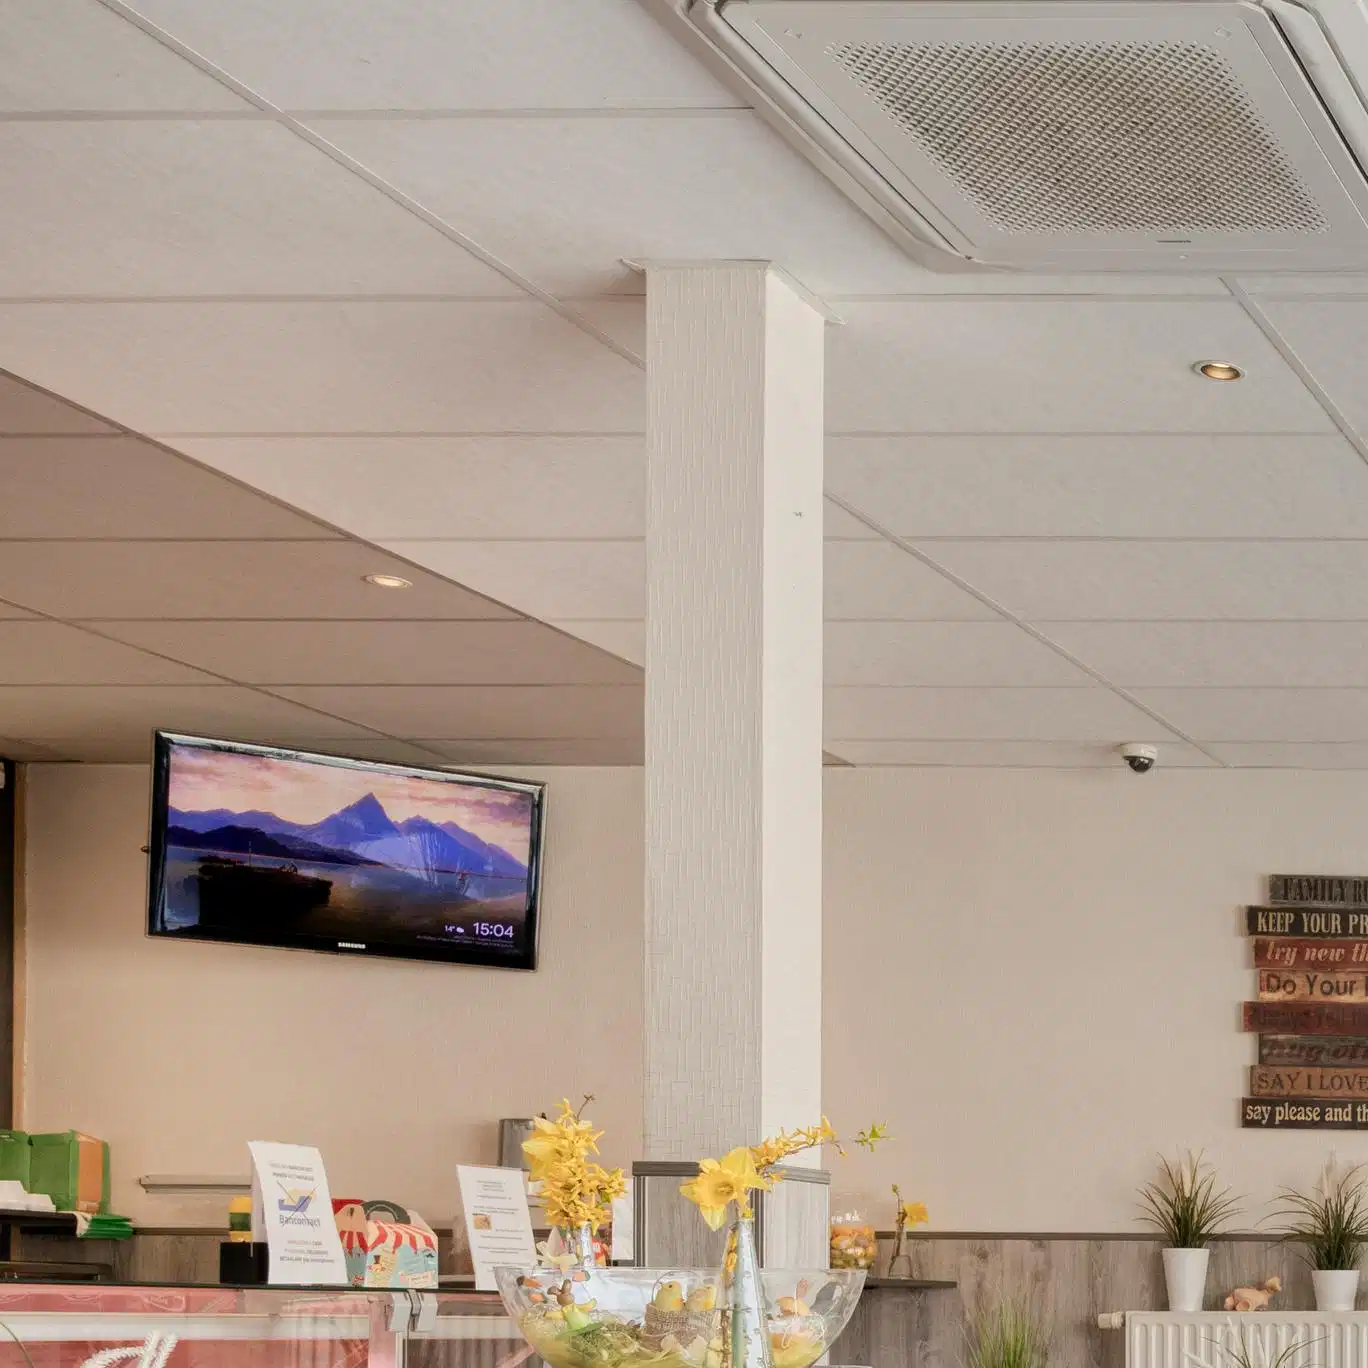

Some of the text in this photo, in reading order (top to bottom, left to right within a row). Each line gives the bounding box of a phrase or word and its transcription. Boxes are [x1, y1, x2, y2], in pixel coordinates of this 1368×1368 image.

[1282, 877, 1350, 902] FAMILY
[473, 922, 514, 938] 15:04
[1257, 911, 1295, 933] KEEP
[1302, 912, 1342, 934] YOUR
[1266, 942, 1299, 966] try
[1304, 949, 1345, 962] new
[1266, 973, 1297, 995] Do
[1305, 974, 1357, 997] Your
[1257, 1073, 1300, 1090] SAY
[1307, 1074, 1313, 1091] I
[1245, 1105, 1271, 1125] say
[1275, 1102, 1321, 1124] please
[1325, 1104, 1352, 1122] and
